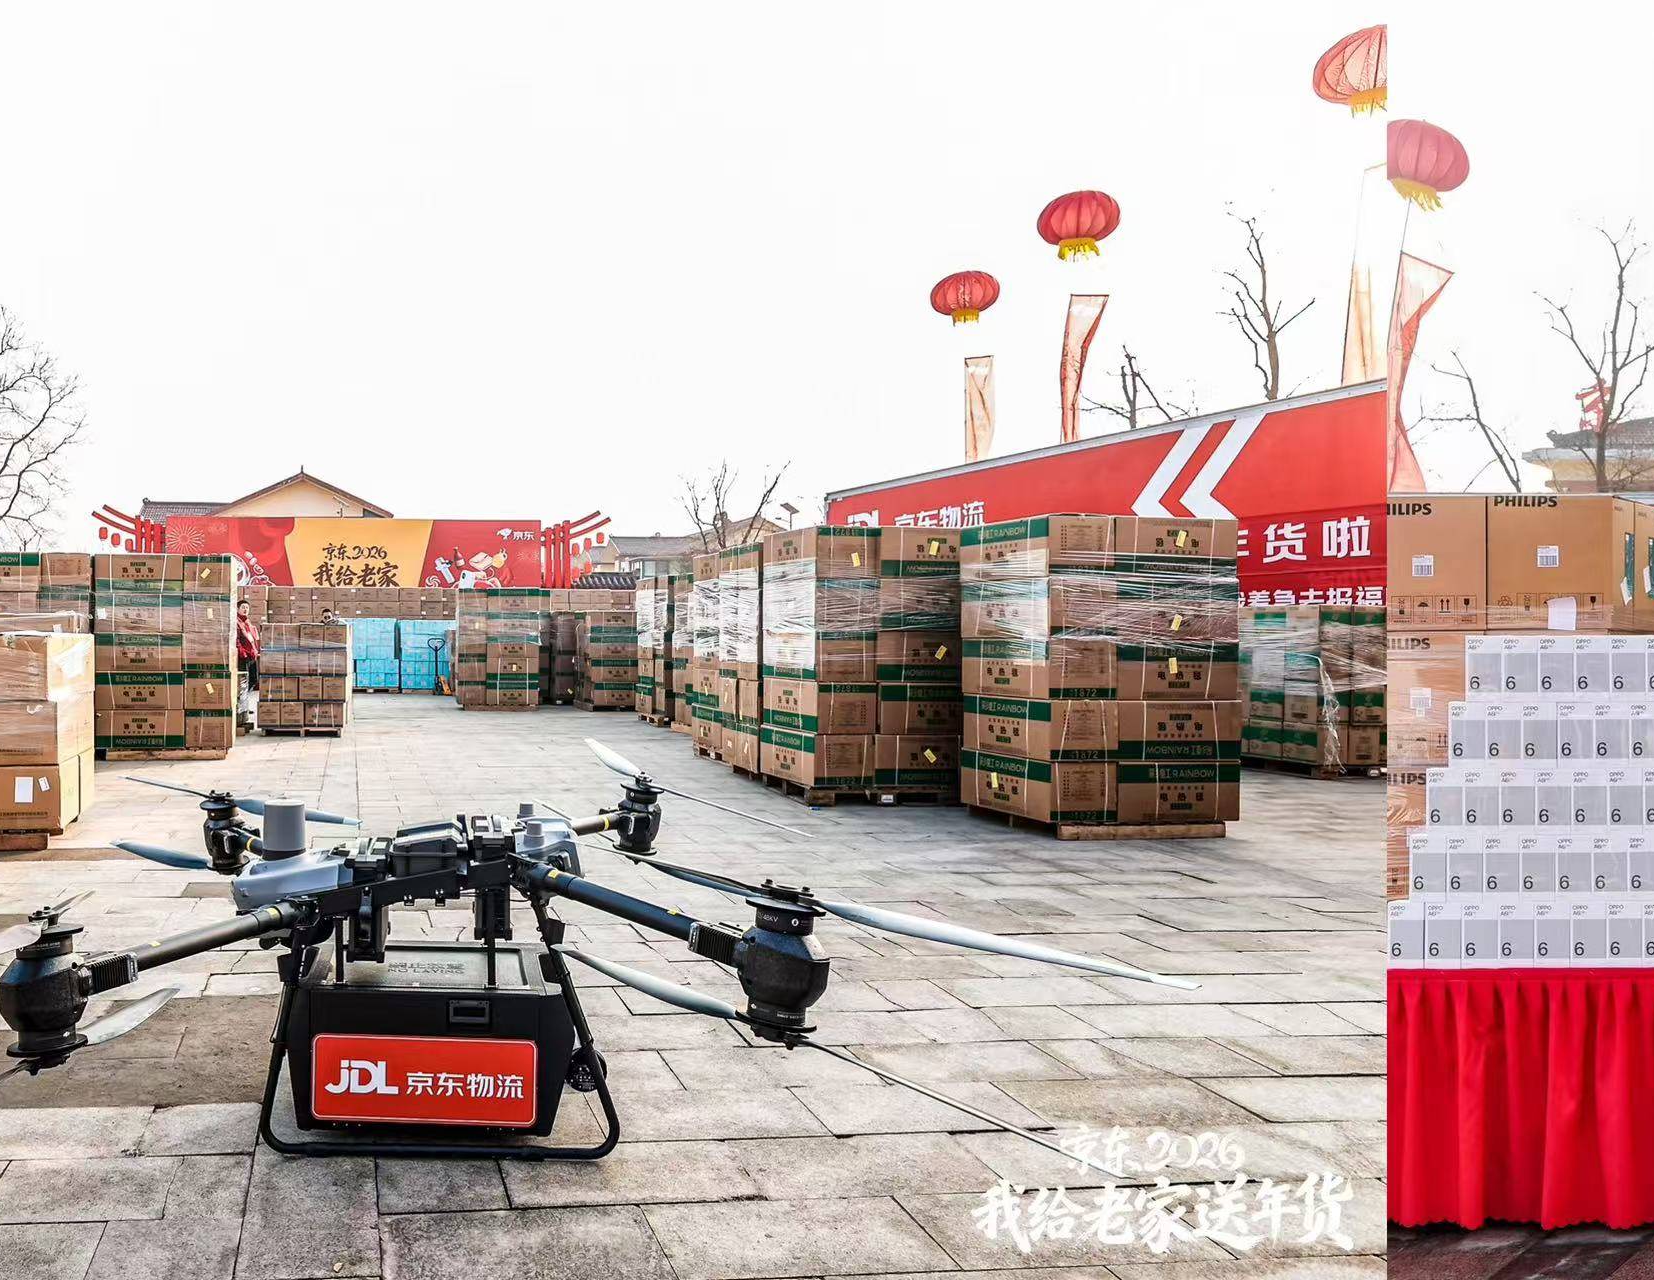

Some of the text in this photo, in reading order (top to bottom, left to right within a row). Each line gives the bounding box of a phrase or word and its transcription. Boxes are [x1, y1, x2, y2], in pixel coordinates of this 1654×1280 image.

[1493, 495, 1558, 508] PHILIPS
[512, 531, 535, 540] 京东
[323, 543, 387, 560] 京东2026
[313, 561, 400, 587] 我给老家
[1469, 675, 1480, 690] 6
[1613, 675, 1624, 690] 6
[996, 703, 1028, 714] RAINBOW
[996, 759, 1028, 773] RAINBOW
[1172, 767, 1215, 778] RAINBOW
[1428, 942, 1440, 957] 6
[324, 1059, 524, 1099] JDL 京东物流
